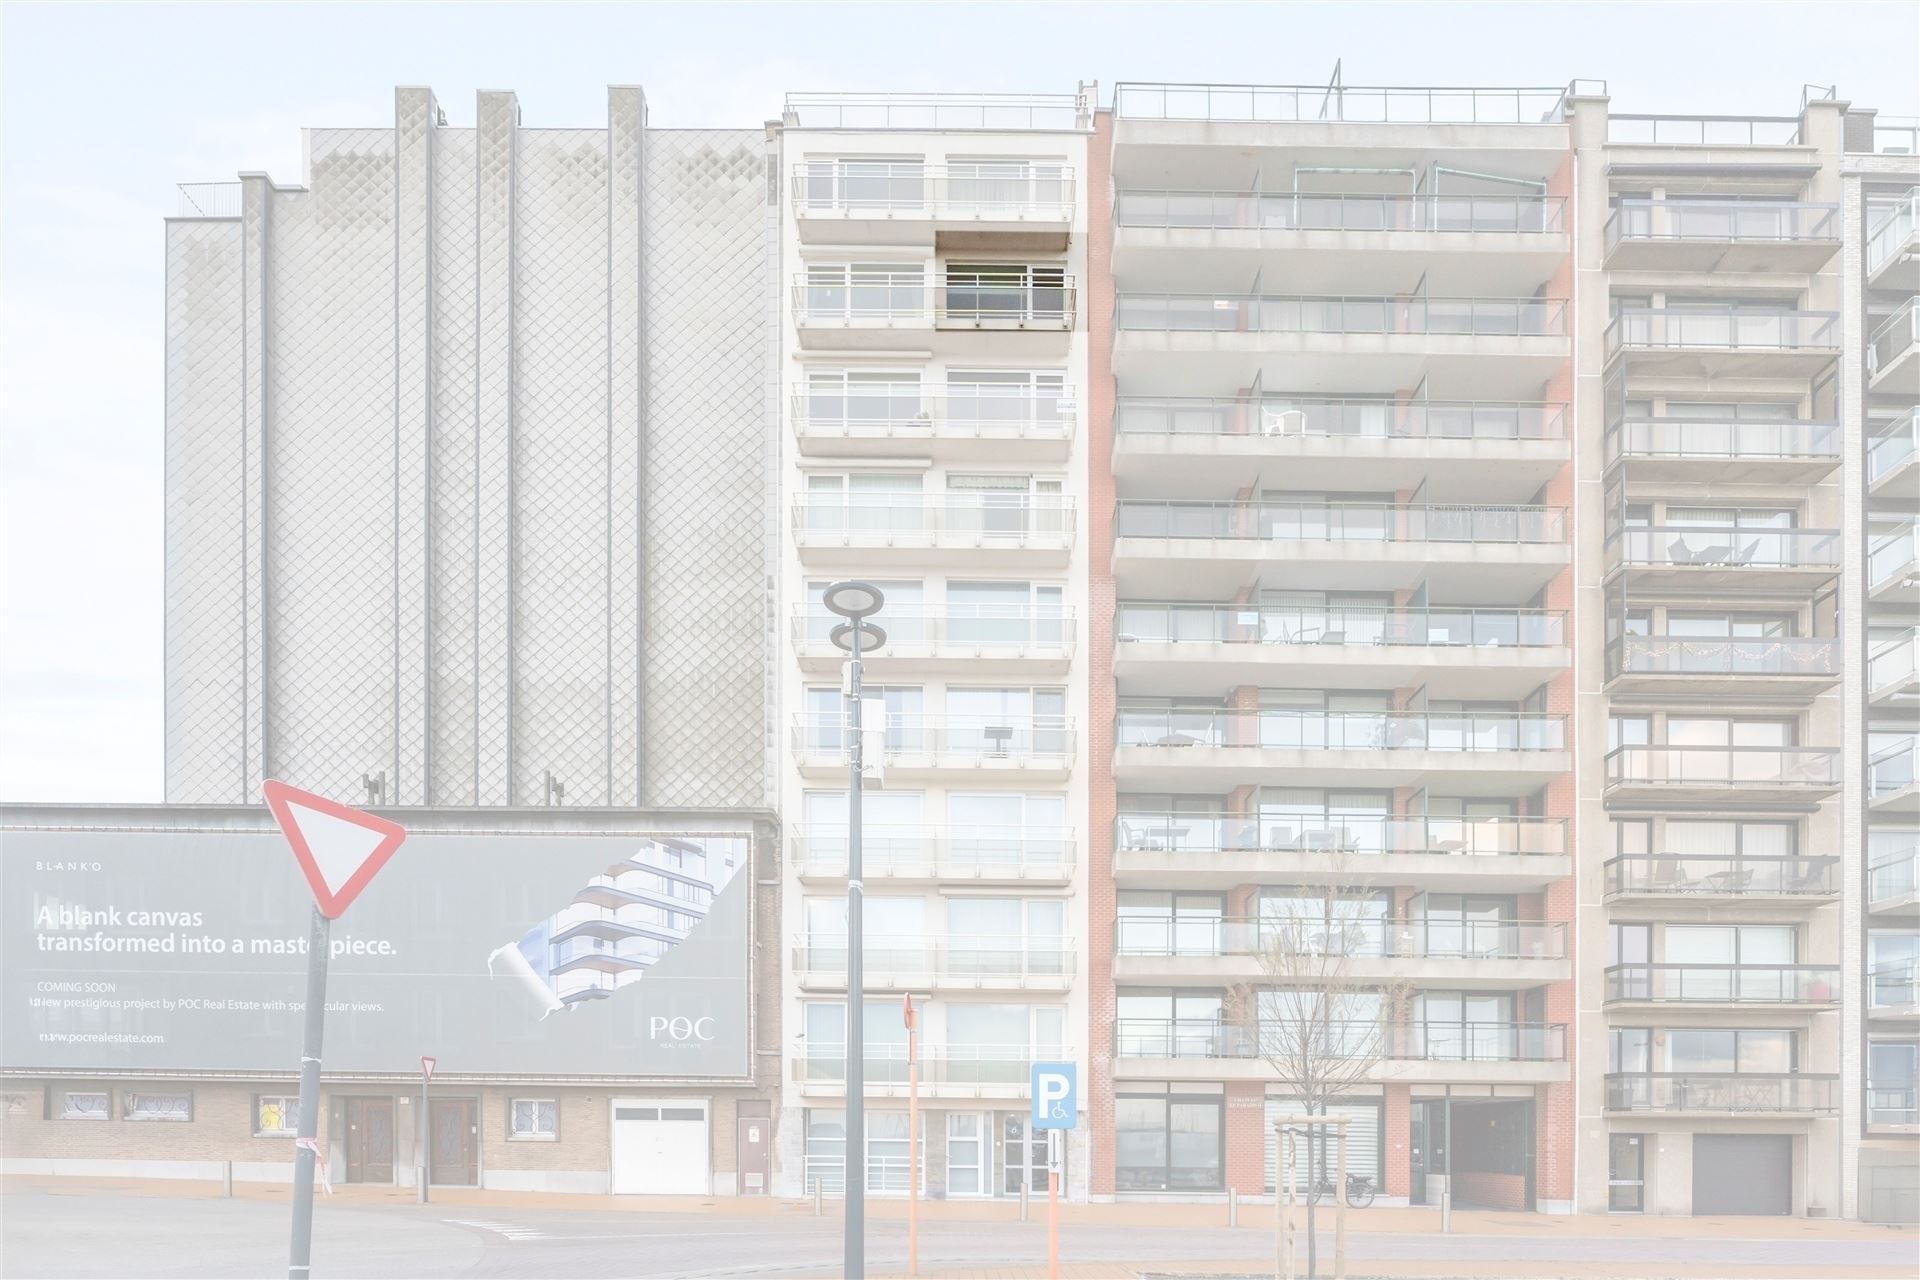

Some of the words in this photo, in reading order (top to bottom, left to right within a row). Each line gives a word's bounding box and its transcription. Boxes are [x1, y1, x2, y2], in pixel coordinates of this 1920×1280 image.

[37, 905, 53, 925] A
[59, 905, 122, 926] blank
[127, 911, 203, 927] canvas
[37, 932, 175, 953] transformed
[181, 933, 225, 954] into
[231, 939, 245, 954] a
[250, 935, 398, 960] mastpiece.
[37, 982, 83, 993] COMING
[85, 982, 116, 993] SOON
[64, 998, 121, 1011] prestigious
[123, 998, 160, 1011] project
[163, 998, 176, 1011] by
[178, 999, 201, 1009] POC
[204, 999, 225, 1010] Real
[228, 1000, 260, 1011] Estate
[262, 1000, 286, 1011] with
[289, 1000, 350, 1015] specular
[351, 1001, 385, 1013] views.
[651, 1016, 716, 1040] POC
[1039, 1074, 1070, 1119] P
